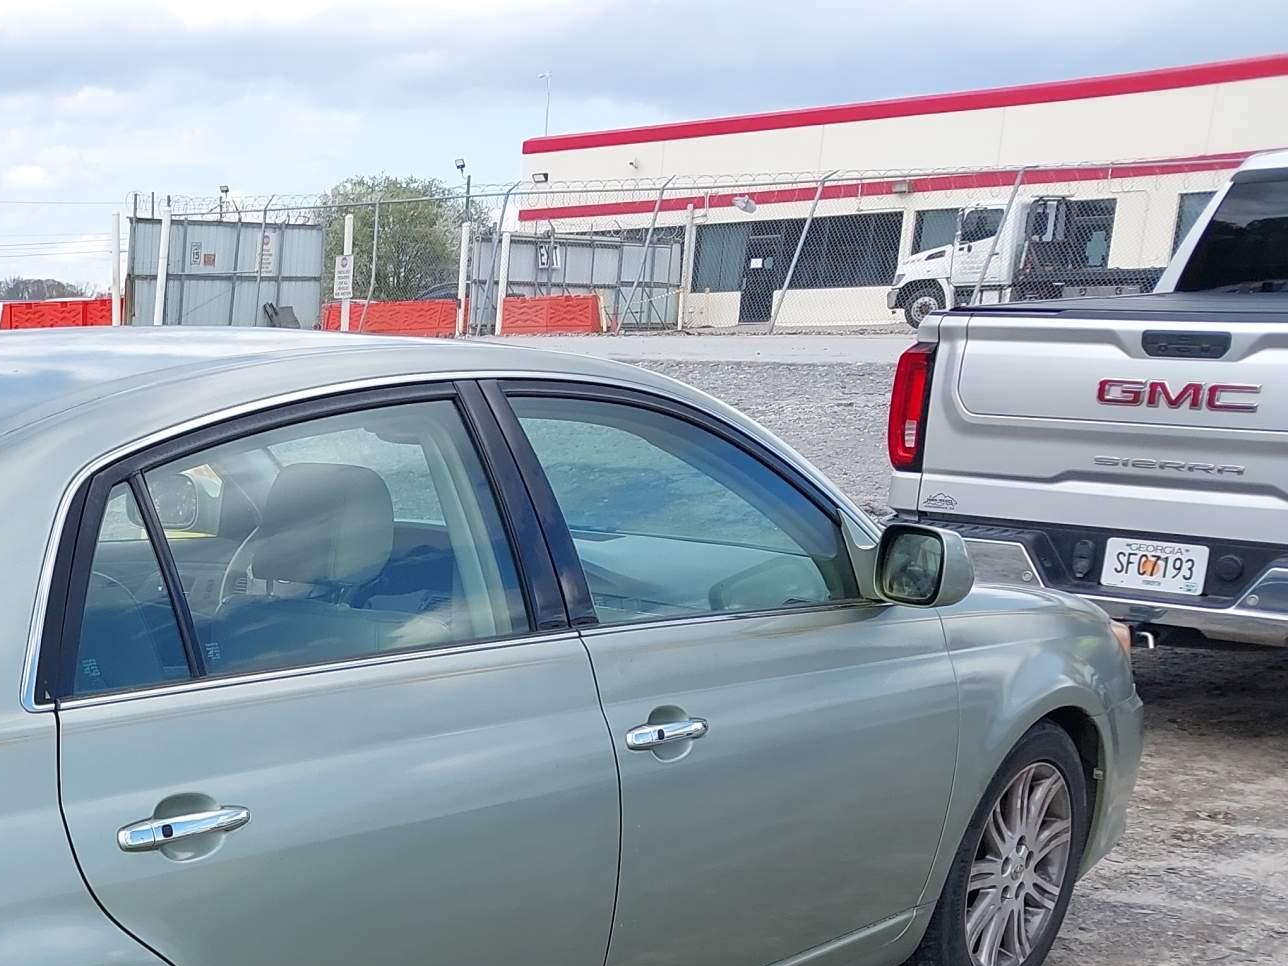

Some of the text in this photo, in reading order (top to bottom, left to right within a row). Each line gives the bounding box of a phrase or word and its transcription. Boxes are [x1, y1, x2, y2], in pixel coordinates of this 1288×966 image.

[538, 245, 560, 266] EXIT
[1096, 376, 1263, 413] GMC
[1093, 455, 1246, 476] SIERRA
[1129, 542, 1184, 556] GEORGIA
[1114, 551, 1195, 581] SFC7193
